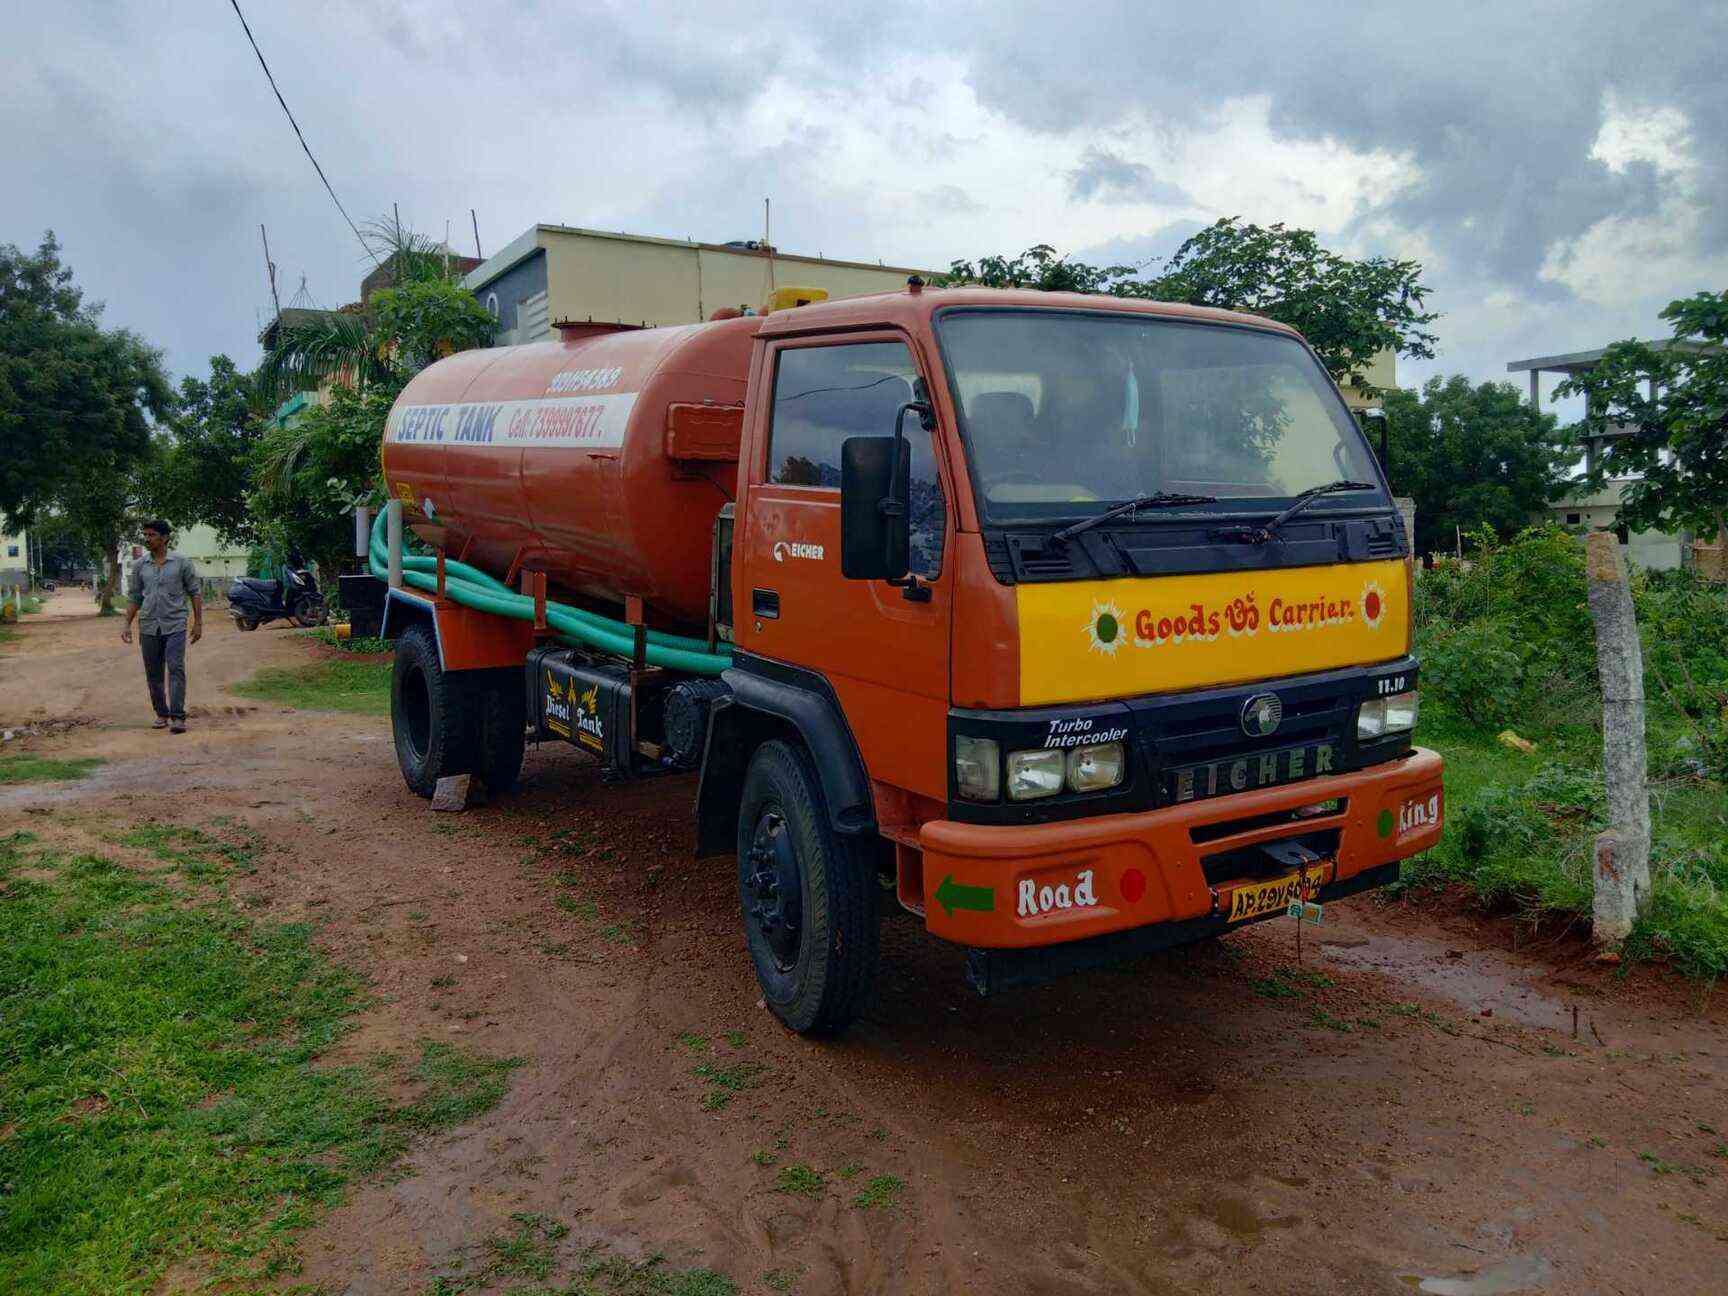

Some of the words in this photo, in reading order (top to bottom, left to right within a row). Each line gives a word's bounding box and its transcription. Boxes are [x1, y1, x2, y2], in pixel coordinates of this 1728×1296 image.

[398, 407, 449, 441] SEPTIC
[455, 404, 505, 442] TANK
[791, 543, 825, 560] EICHER
[1135, 604, 1221, 645] Goods
[1044, 727, 1128, 748] Intercooler
[1049, 718, 1093, 734] Turbo
[1176, 743, 1334, 802] EICHER
[1017, 868, 1100, 918] Road
